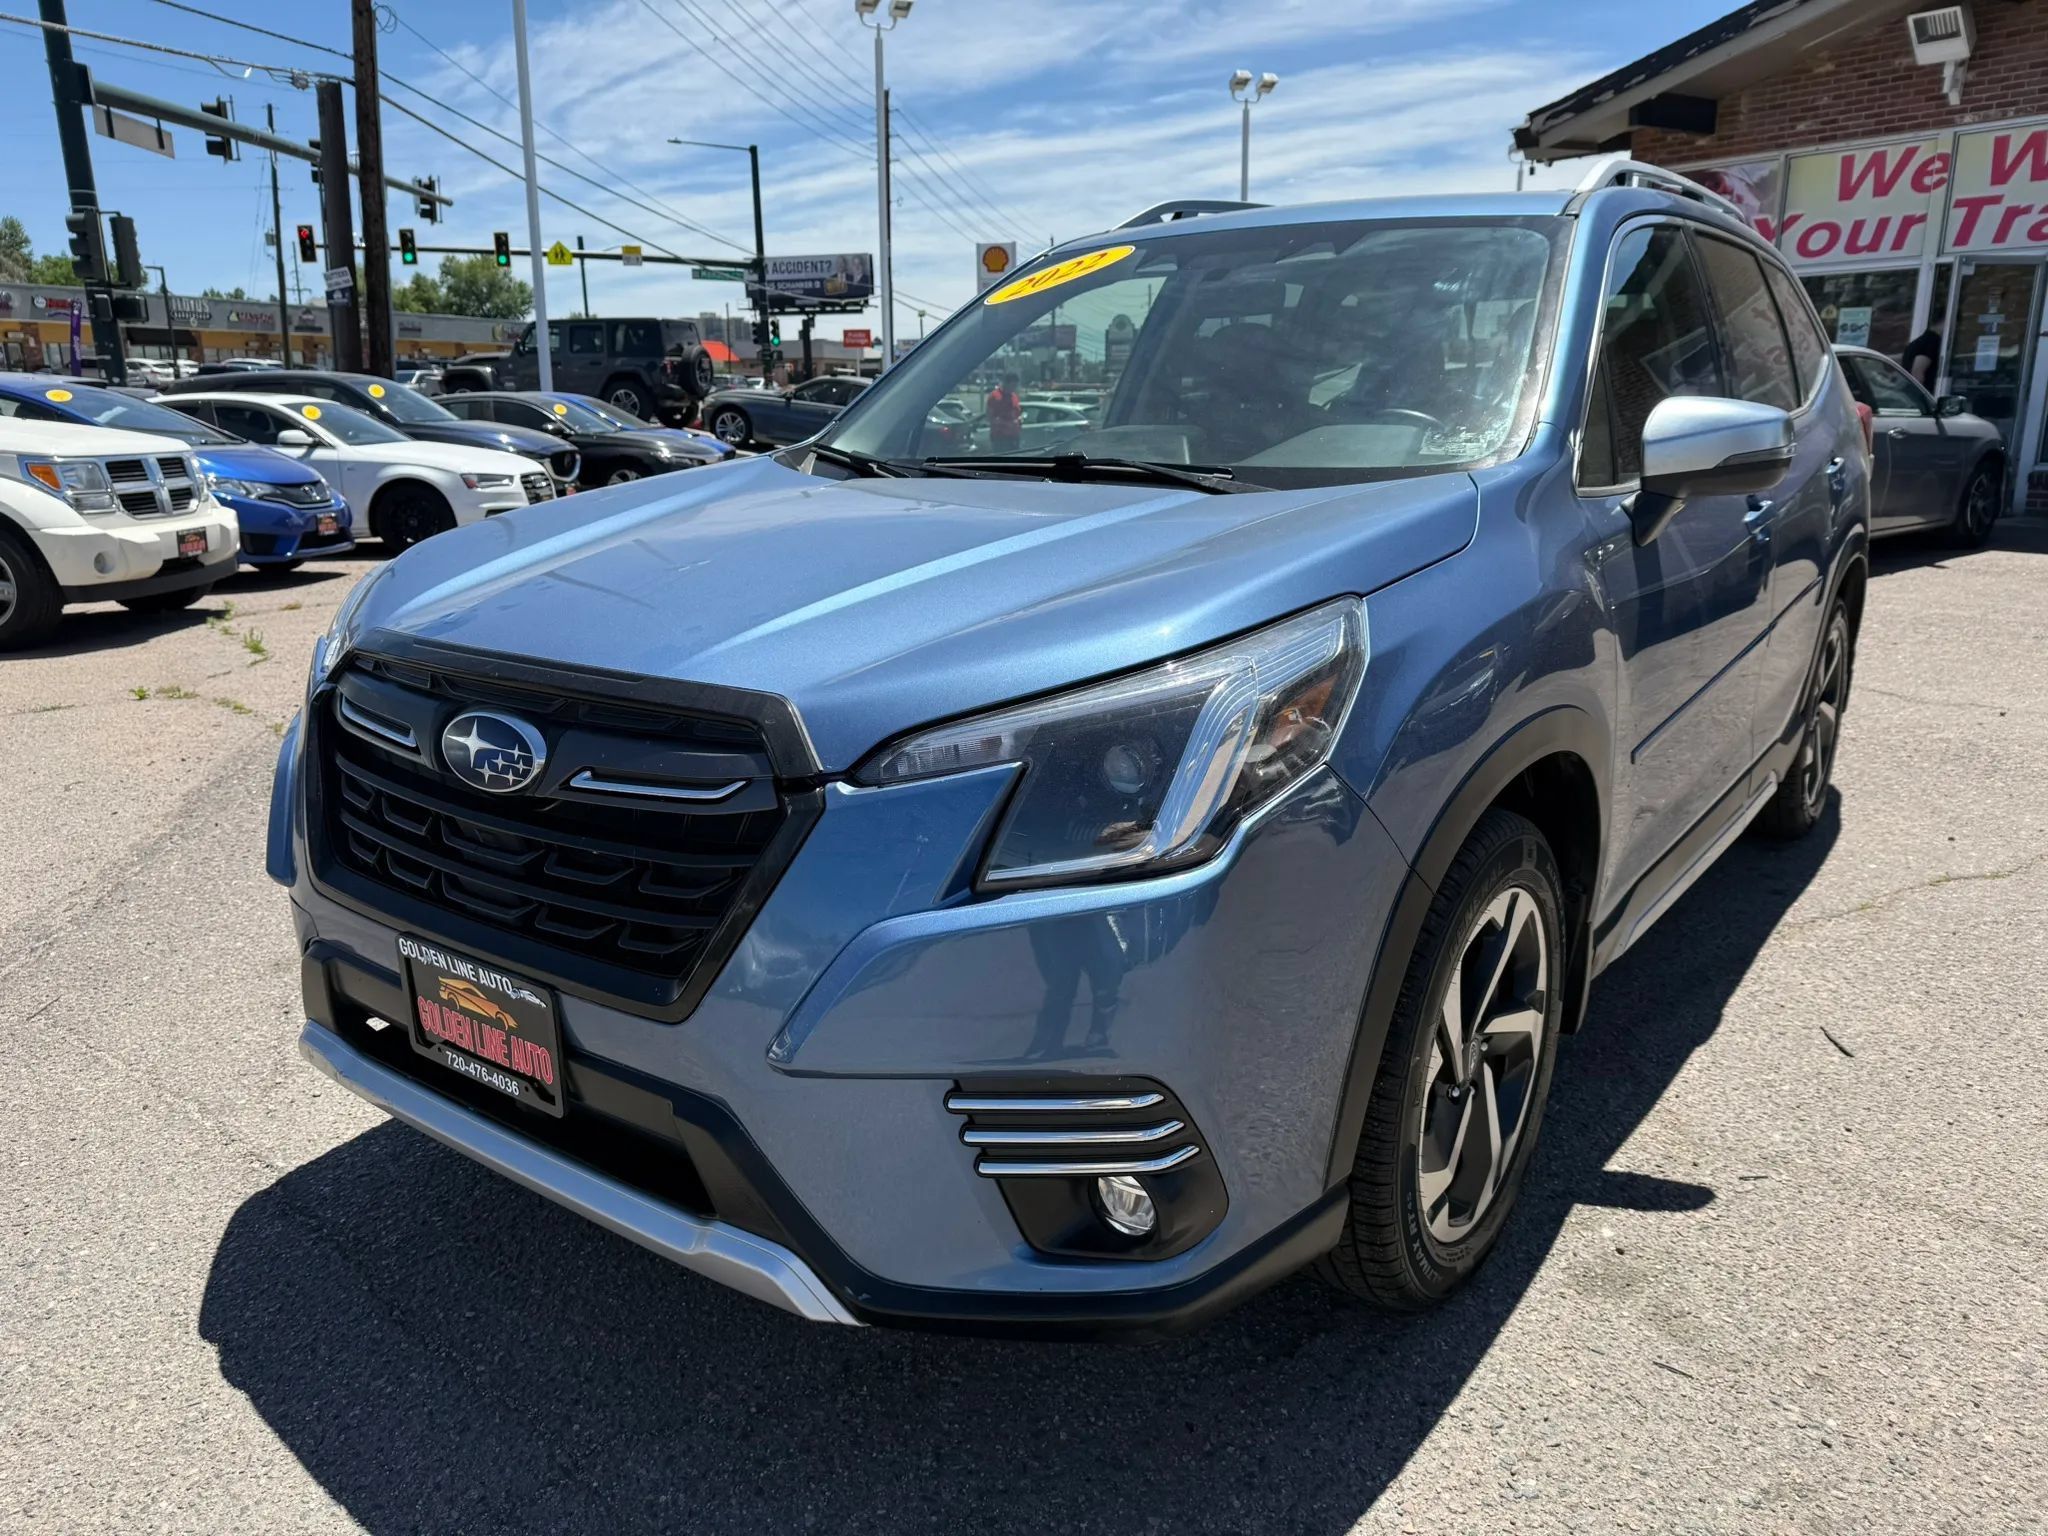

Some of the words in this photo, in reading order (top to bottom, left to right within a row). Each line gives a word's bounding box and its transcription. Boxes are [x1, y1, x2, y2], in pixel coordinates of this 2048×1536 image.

[1838, 146, 1951, 201] We
[1753, 212, 1928, 258] Your
[771, 261, 832, 274] ACCIDENT?
[1004, 252, 1109, 299] 2022
[399, 938, 448, 971] GOLDEN
[447, 956, 478, 982] LINE
[478, 968, 513, 993] AUTO
[418, 995, 474, 1052] GOLDEN
[473, 1020, 510, 1068] LINE
[511, 1035, 553, 1085] AUTO
[446, 1051, 519, 1096] 720-476-4036
[1412, 1239, 1442, 1284] LTIMAX
